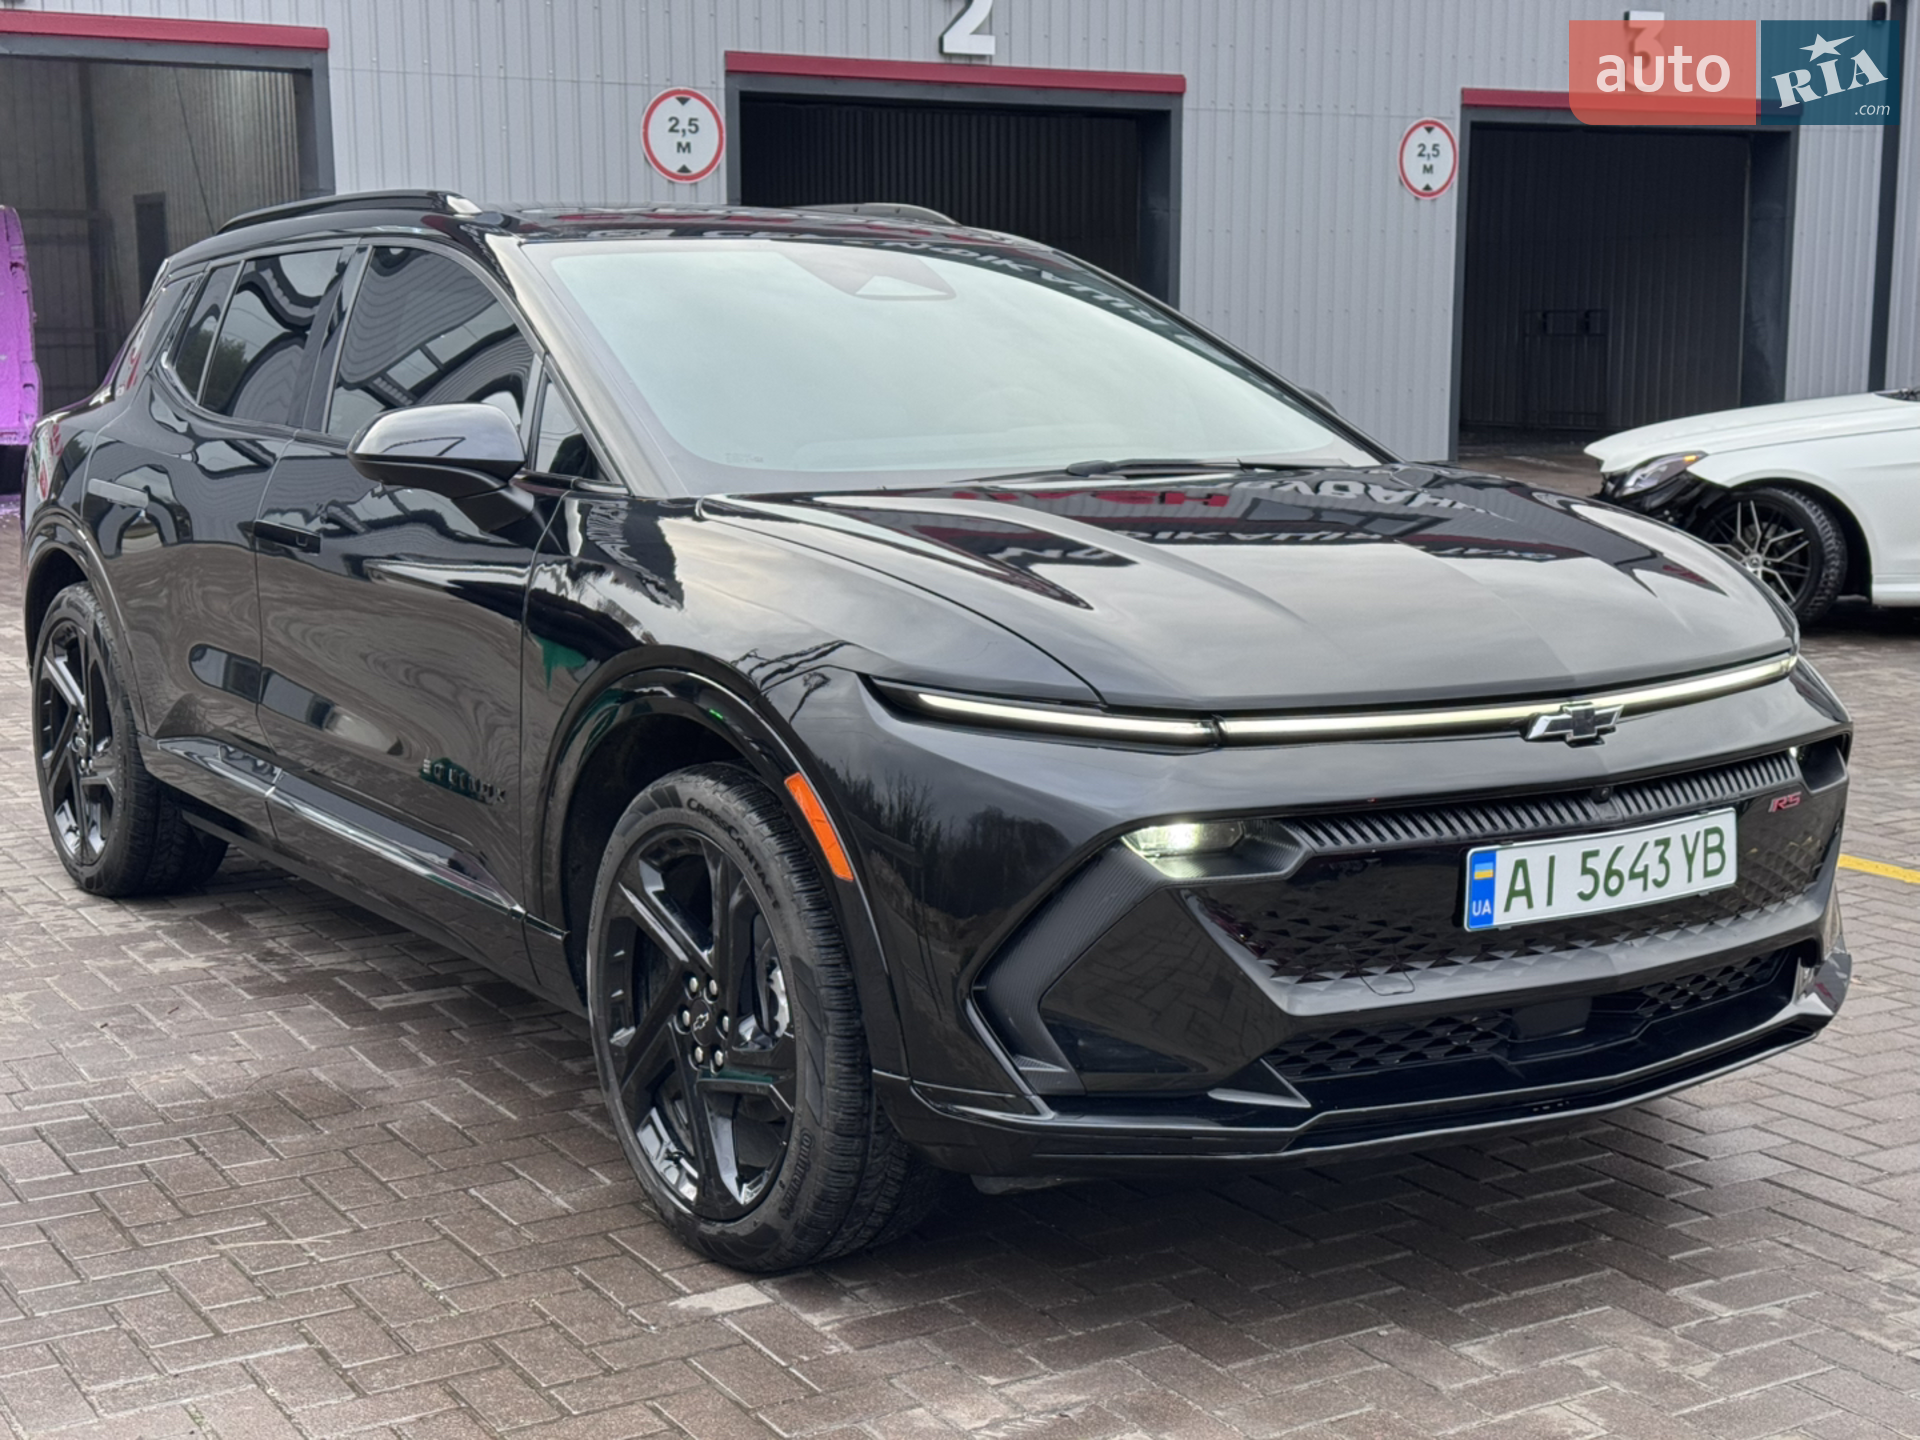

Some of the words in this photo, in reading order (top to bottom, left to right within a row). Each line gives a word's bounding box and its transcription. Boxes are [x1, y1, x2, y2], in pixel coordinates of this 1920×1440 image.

[667, 116, 700, 138] 2,5
[1417, 143, 1440, 161] 2,5
[1768, 791, 1802, 813] RS
[1503, 854, 1556, 913] AI
[1576, 836, 1672, 902] 5643
[1680, 825, 1727, 884] YB
[1471, 899, 1492, 917] UA
